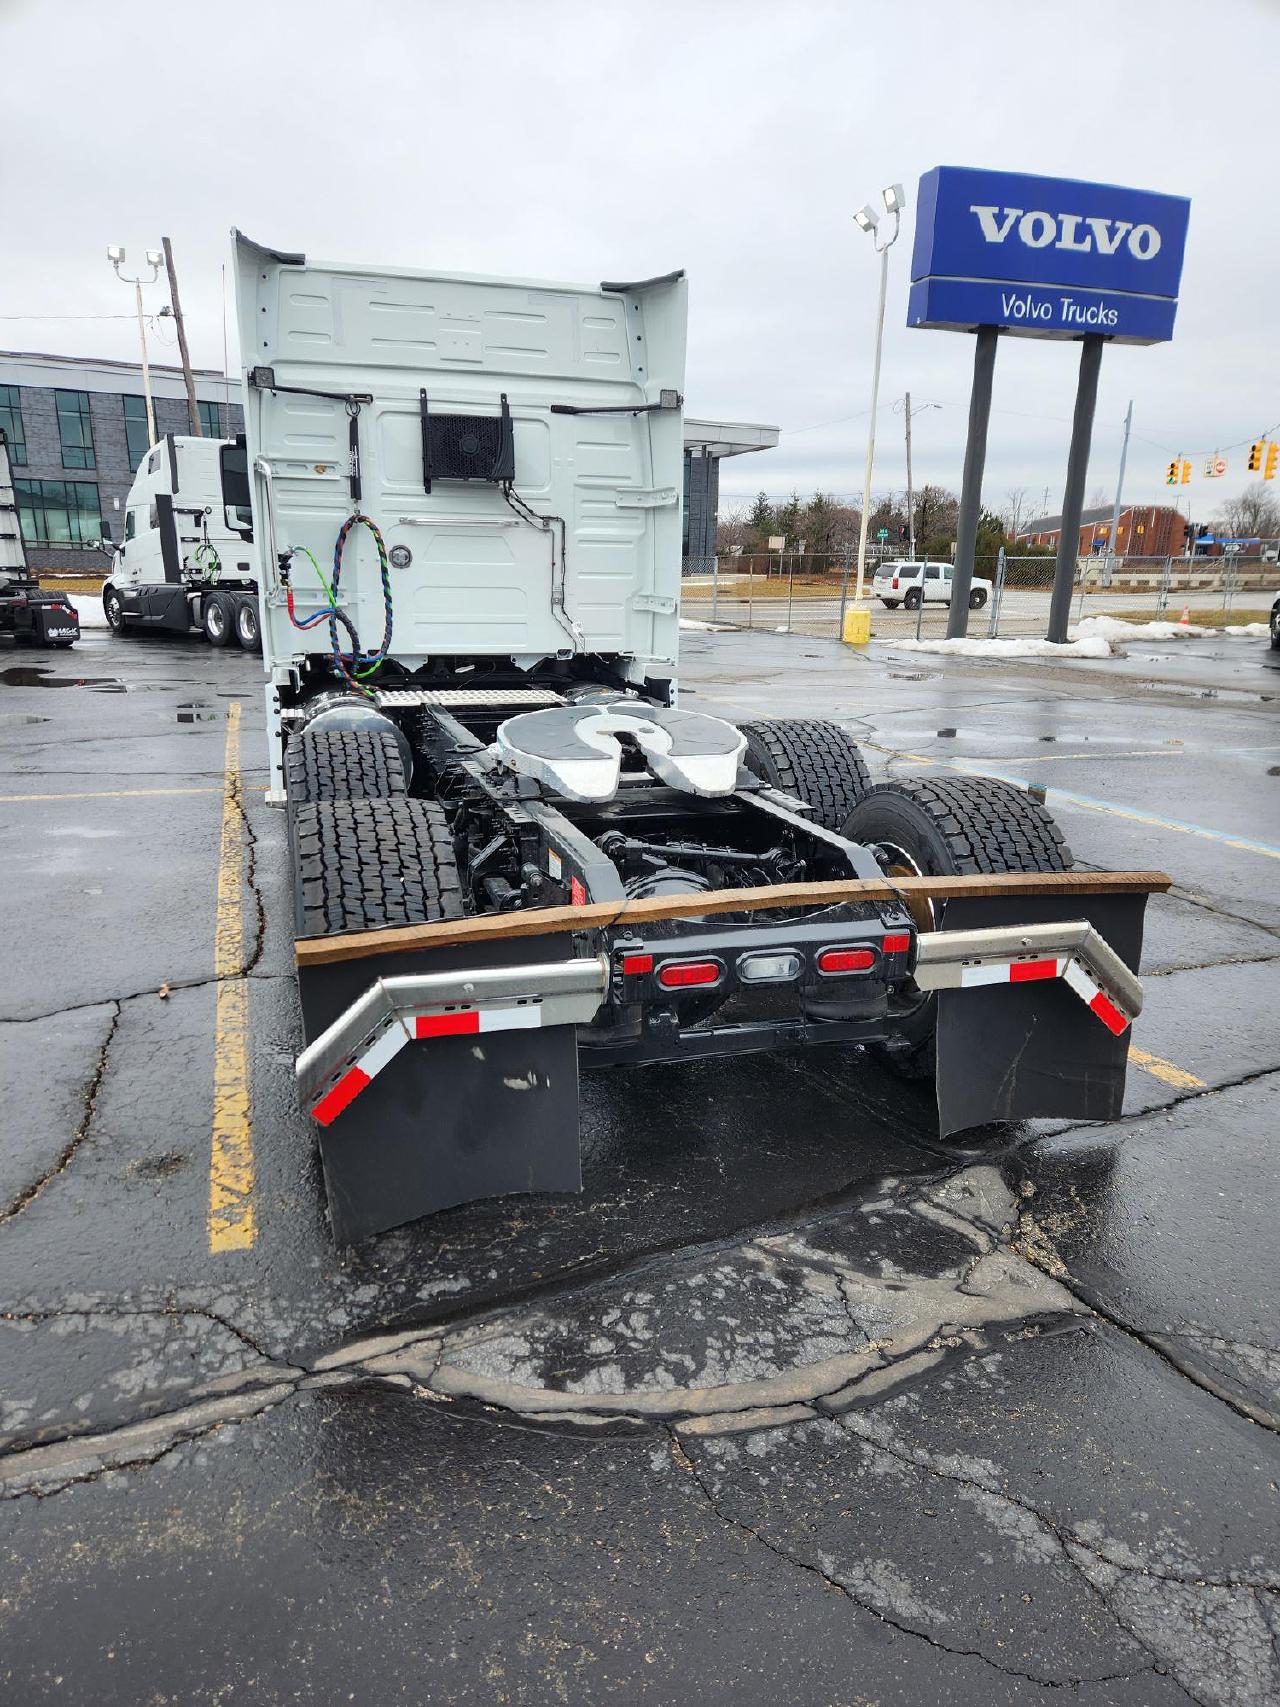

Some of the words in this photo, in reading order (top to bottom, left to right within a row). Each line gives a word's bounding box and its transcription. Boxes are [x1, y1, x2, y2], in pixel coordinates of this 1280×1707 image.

[970, 205, 1161, 260] VOLVO
[1002, 293, 1052, 319] Volvo
[1060, 297, 1118, 325] Trucks
